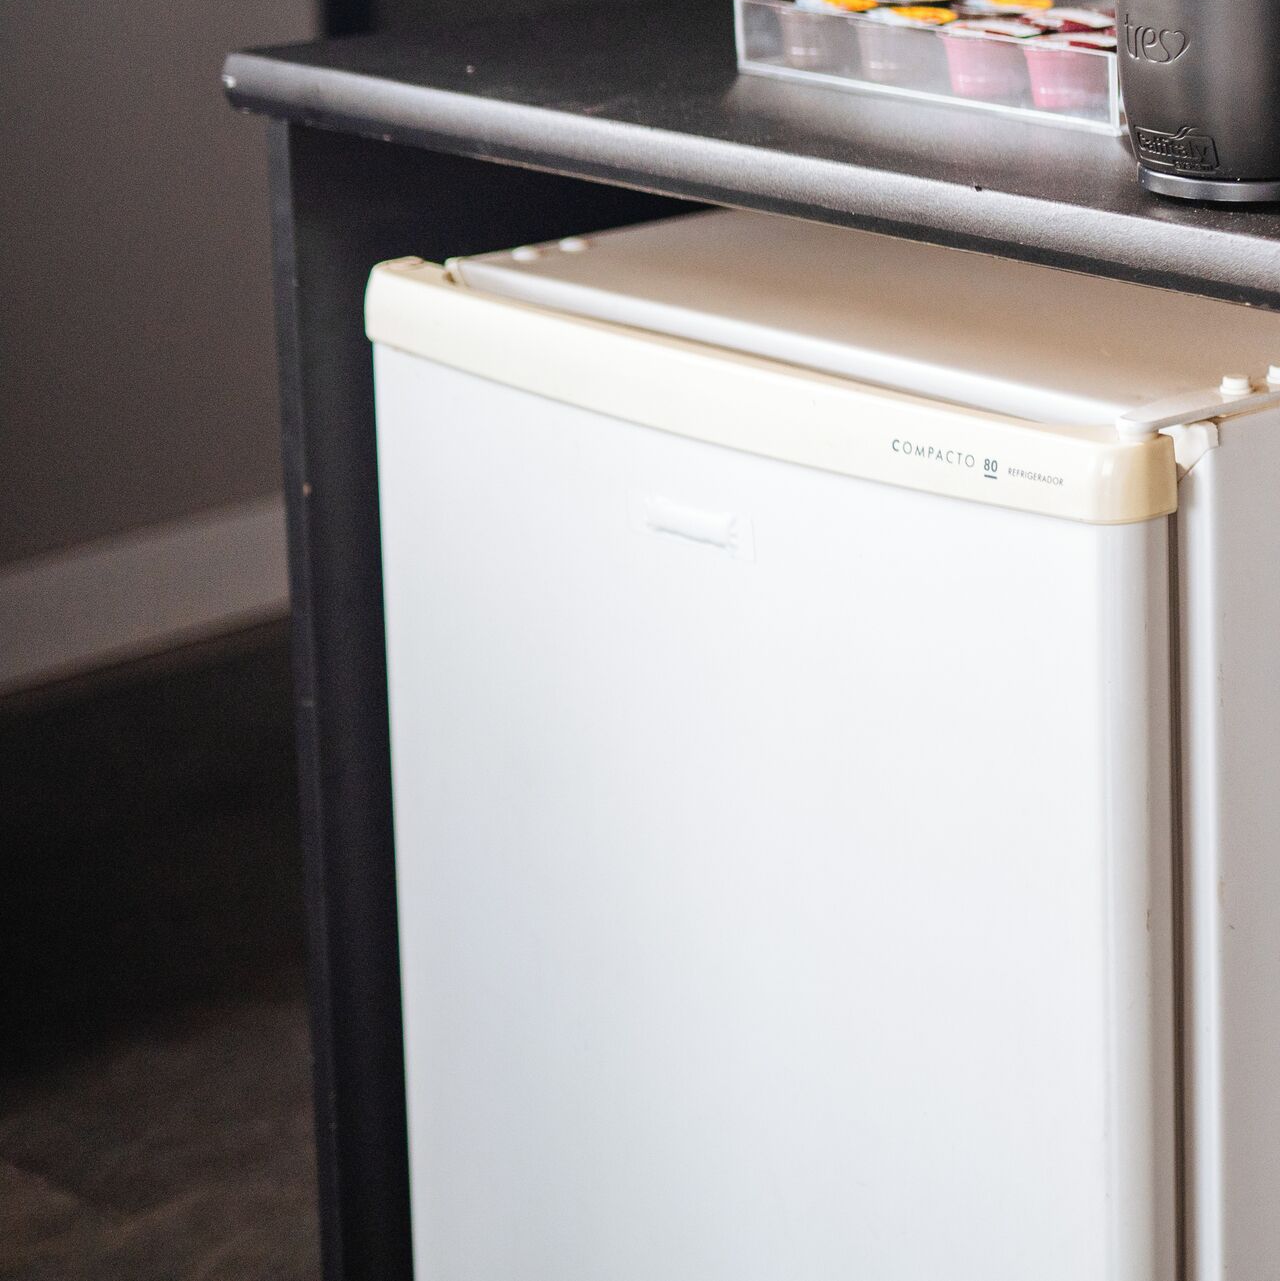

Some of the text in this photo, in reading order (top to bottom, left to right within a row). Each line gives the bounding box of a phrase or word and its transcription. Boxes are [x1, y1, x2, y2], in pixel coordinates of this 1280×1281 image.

[892, 439, 1064, 487] COMPACTO 80 REFRIGERADOR
